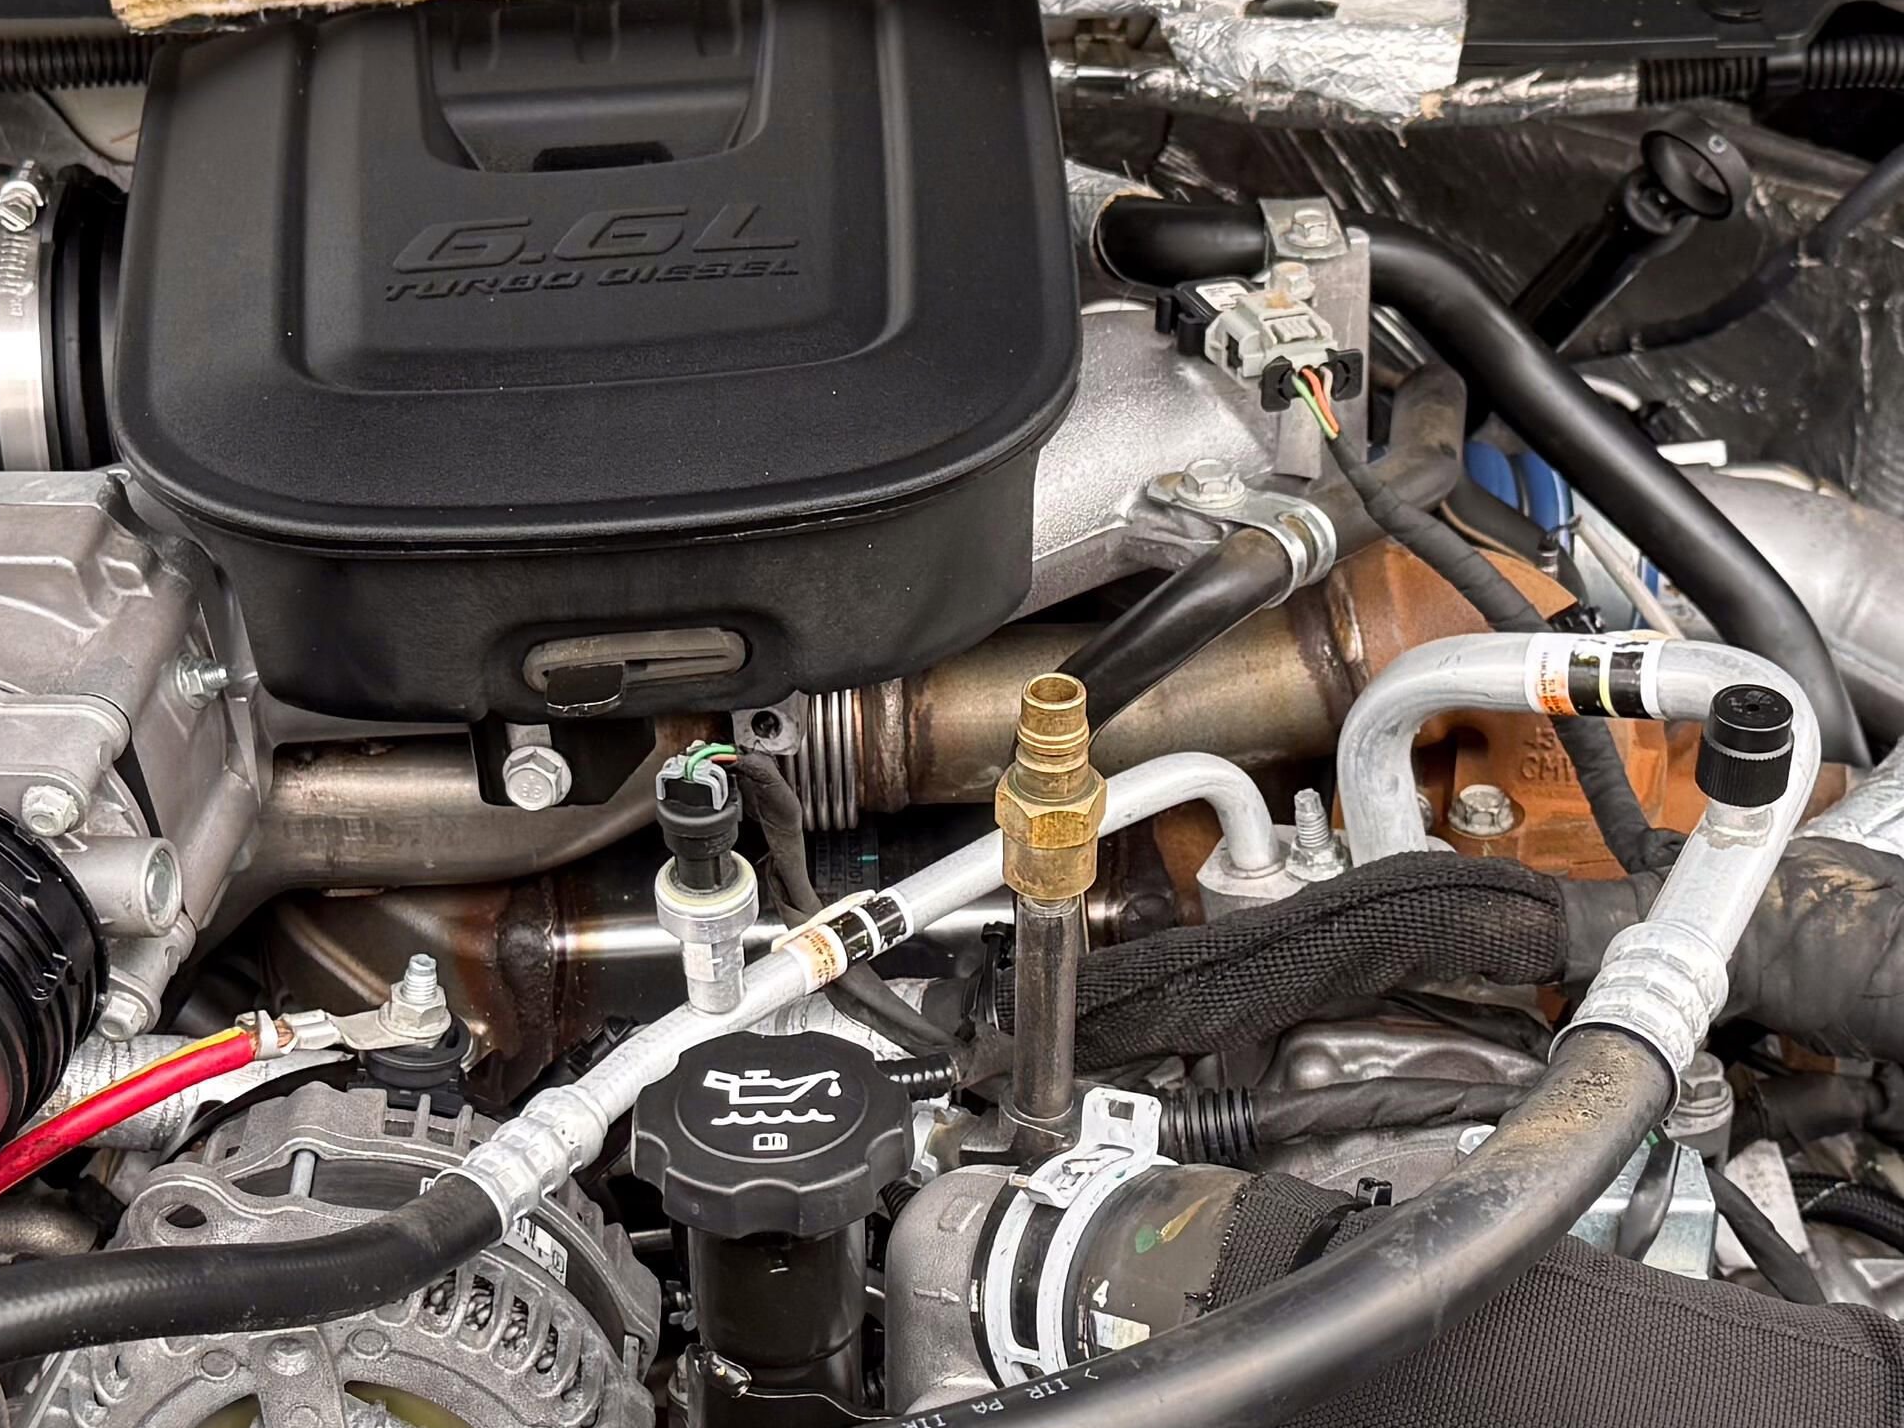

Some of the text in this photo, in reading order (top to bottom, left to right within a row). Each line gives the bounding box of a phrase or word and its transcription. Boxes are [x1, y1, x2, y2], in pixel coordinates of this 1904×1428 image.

[393, 203, 799, 272] 6.6L
[386, 258, 799, 301] TURBO DIESEL
[971, 1397, 1005, 1415] PA
